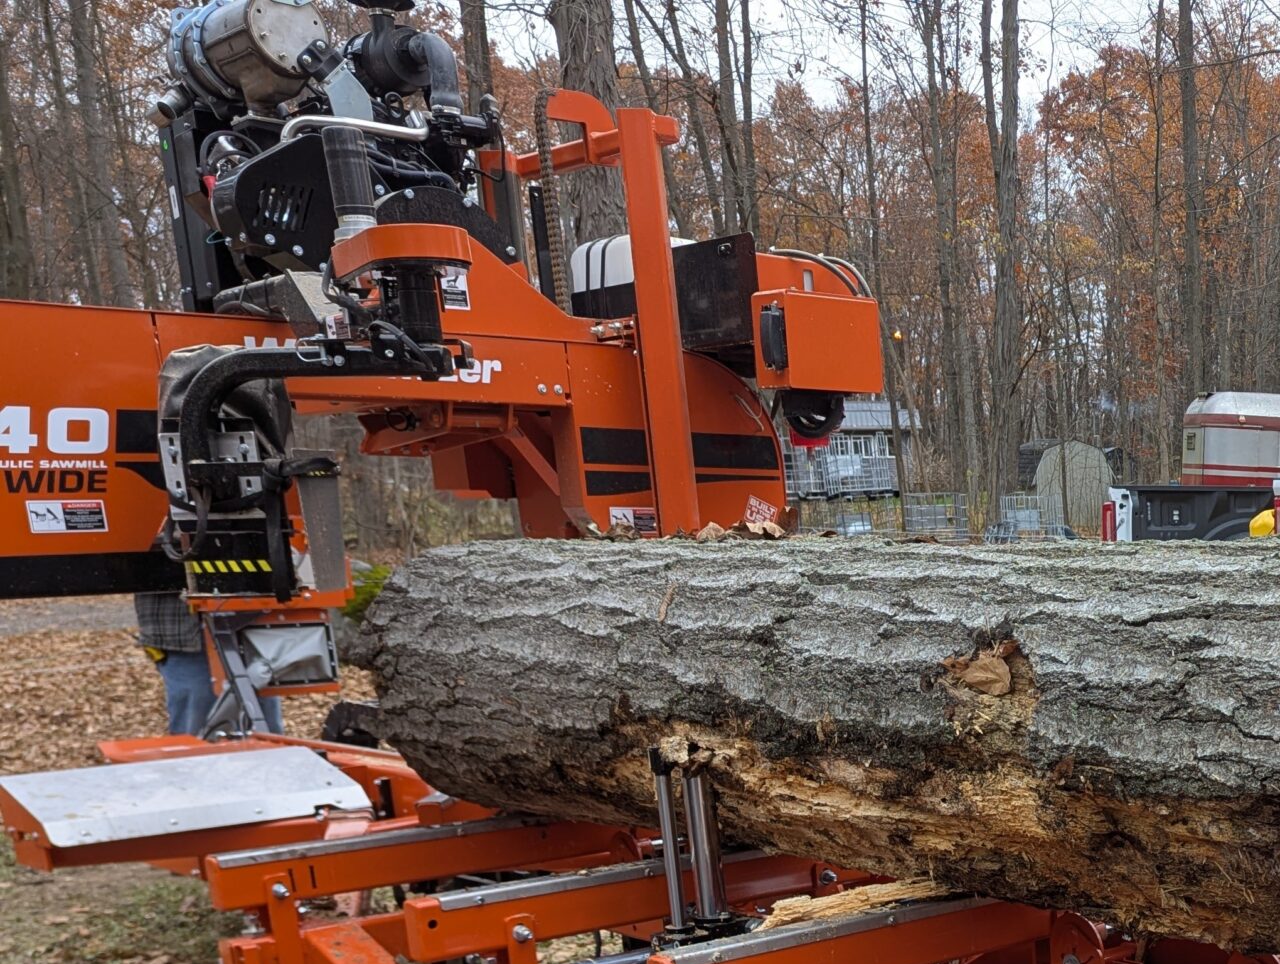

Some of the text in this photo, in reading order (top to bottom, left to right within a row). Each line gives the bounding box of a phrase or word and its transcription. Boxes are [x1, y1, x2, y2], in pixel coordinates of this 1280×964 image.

[39, 459, 108, 469] SAWMILL
[4, 469, 108, 494] WIDE
[749, 497, 776, 515] BUILT
[746, 508, 769, 524] US
